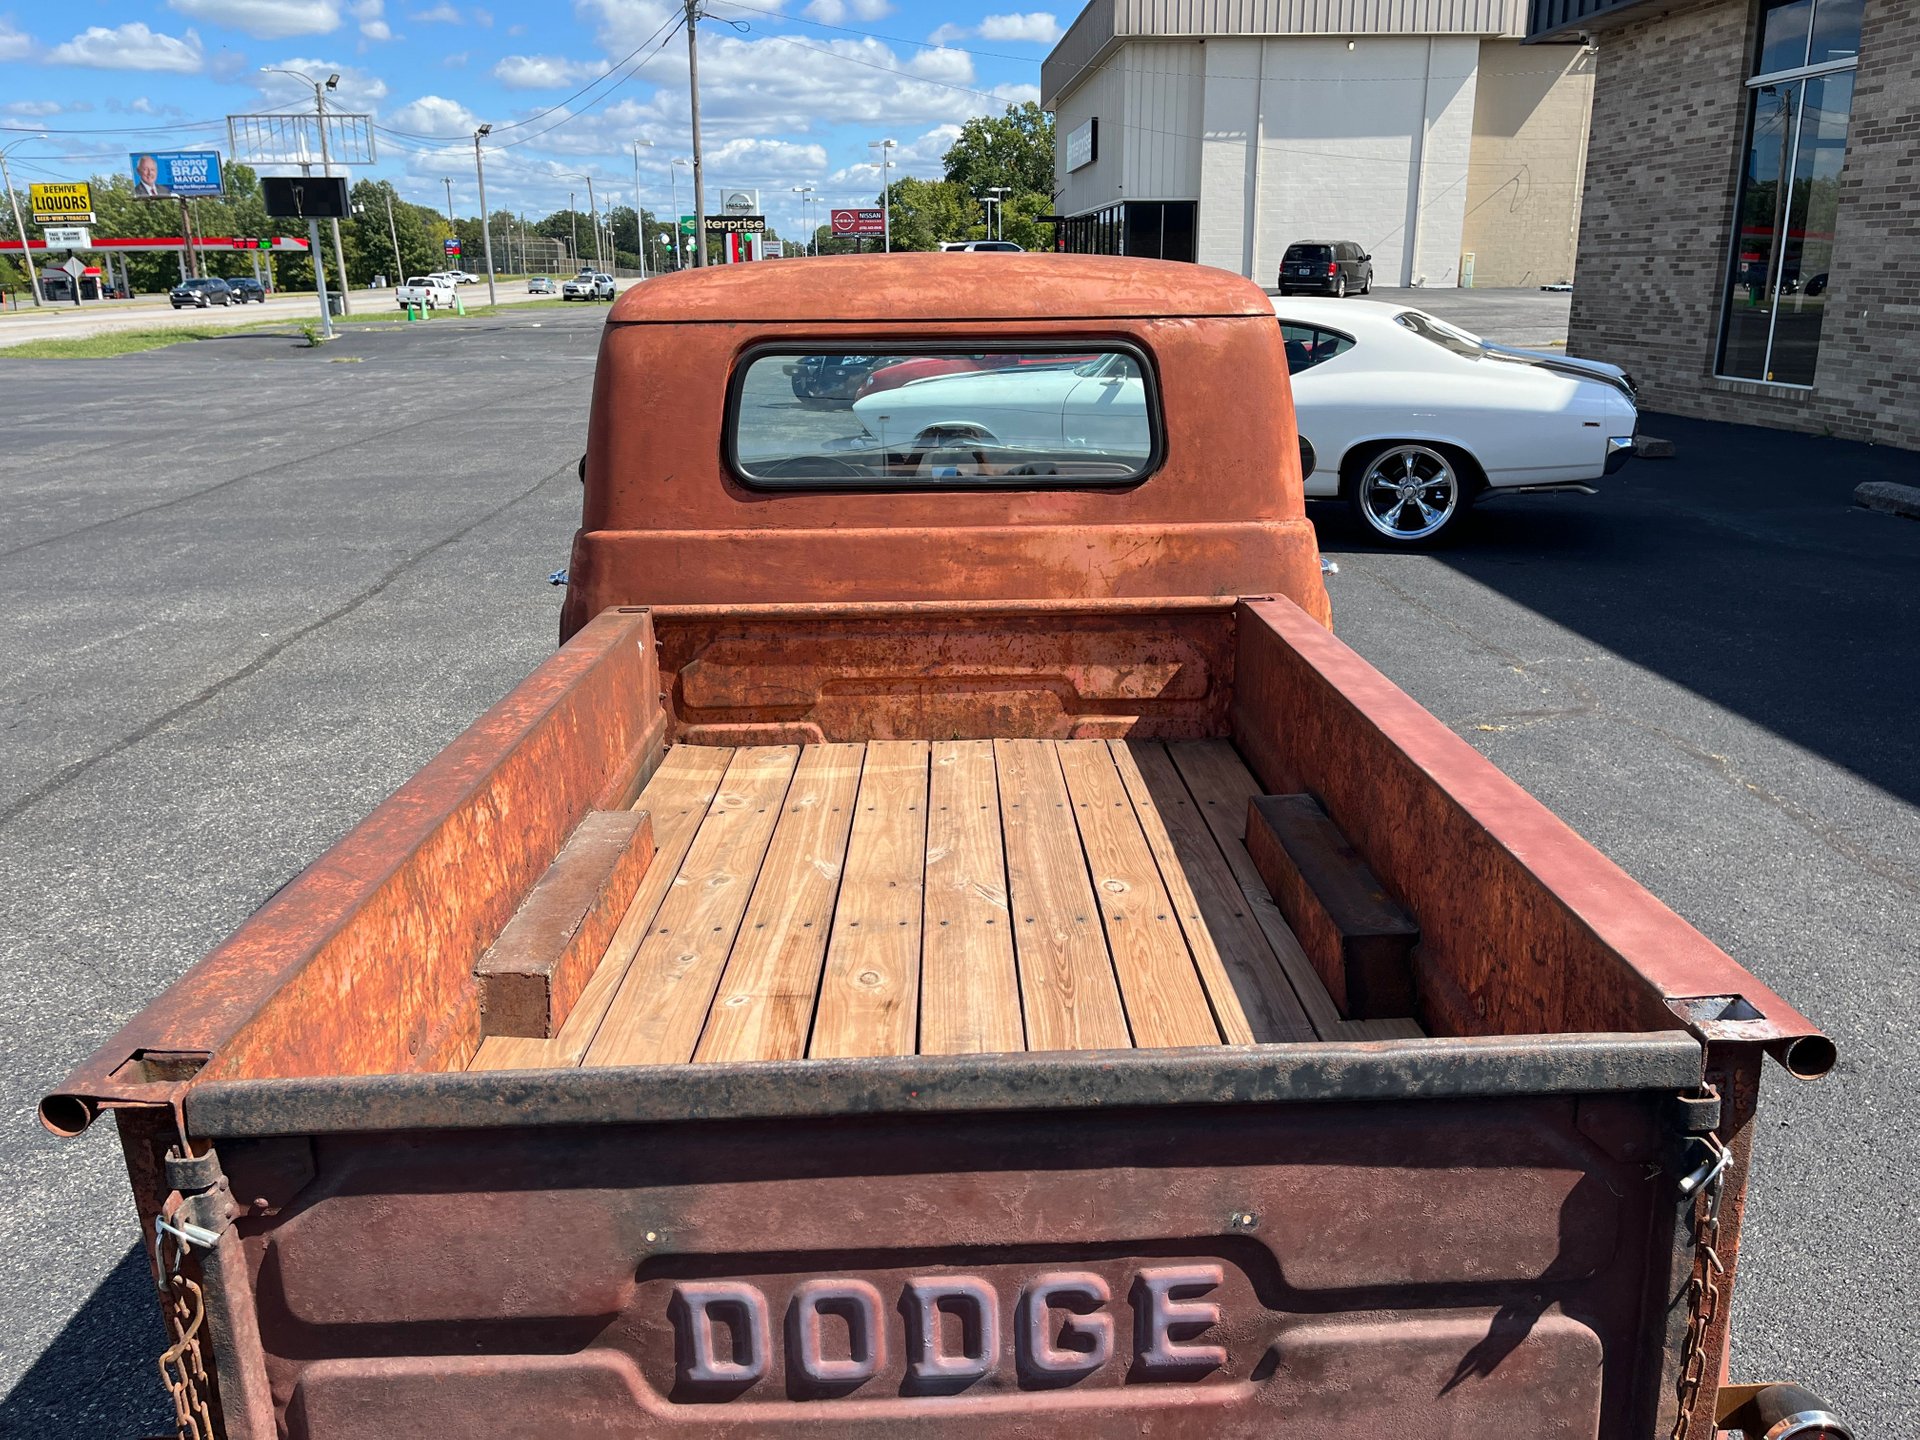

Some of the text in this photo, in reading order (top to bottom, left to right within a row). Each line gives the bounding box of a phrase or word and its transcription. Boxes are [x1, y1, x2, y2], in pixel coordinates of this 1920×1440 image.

[170, 159, 208, 167] GEORGE
[171, 166, 208, 176] BRAY
[174, 175, 207, 183] MAYOR
[43, 185, 77, 194] BEEHIVE
[35, 196, 87, 211] LIQUORS
[686, 218, 764, 231] eterprise
[671, 1263, 1227, 1388] DODGE
